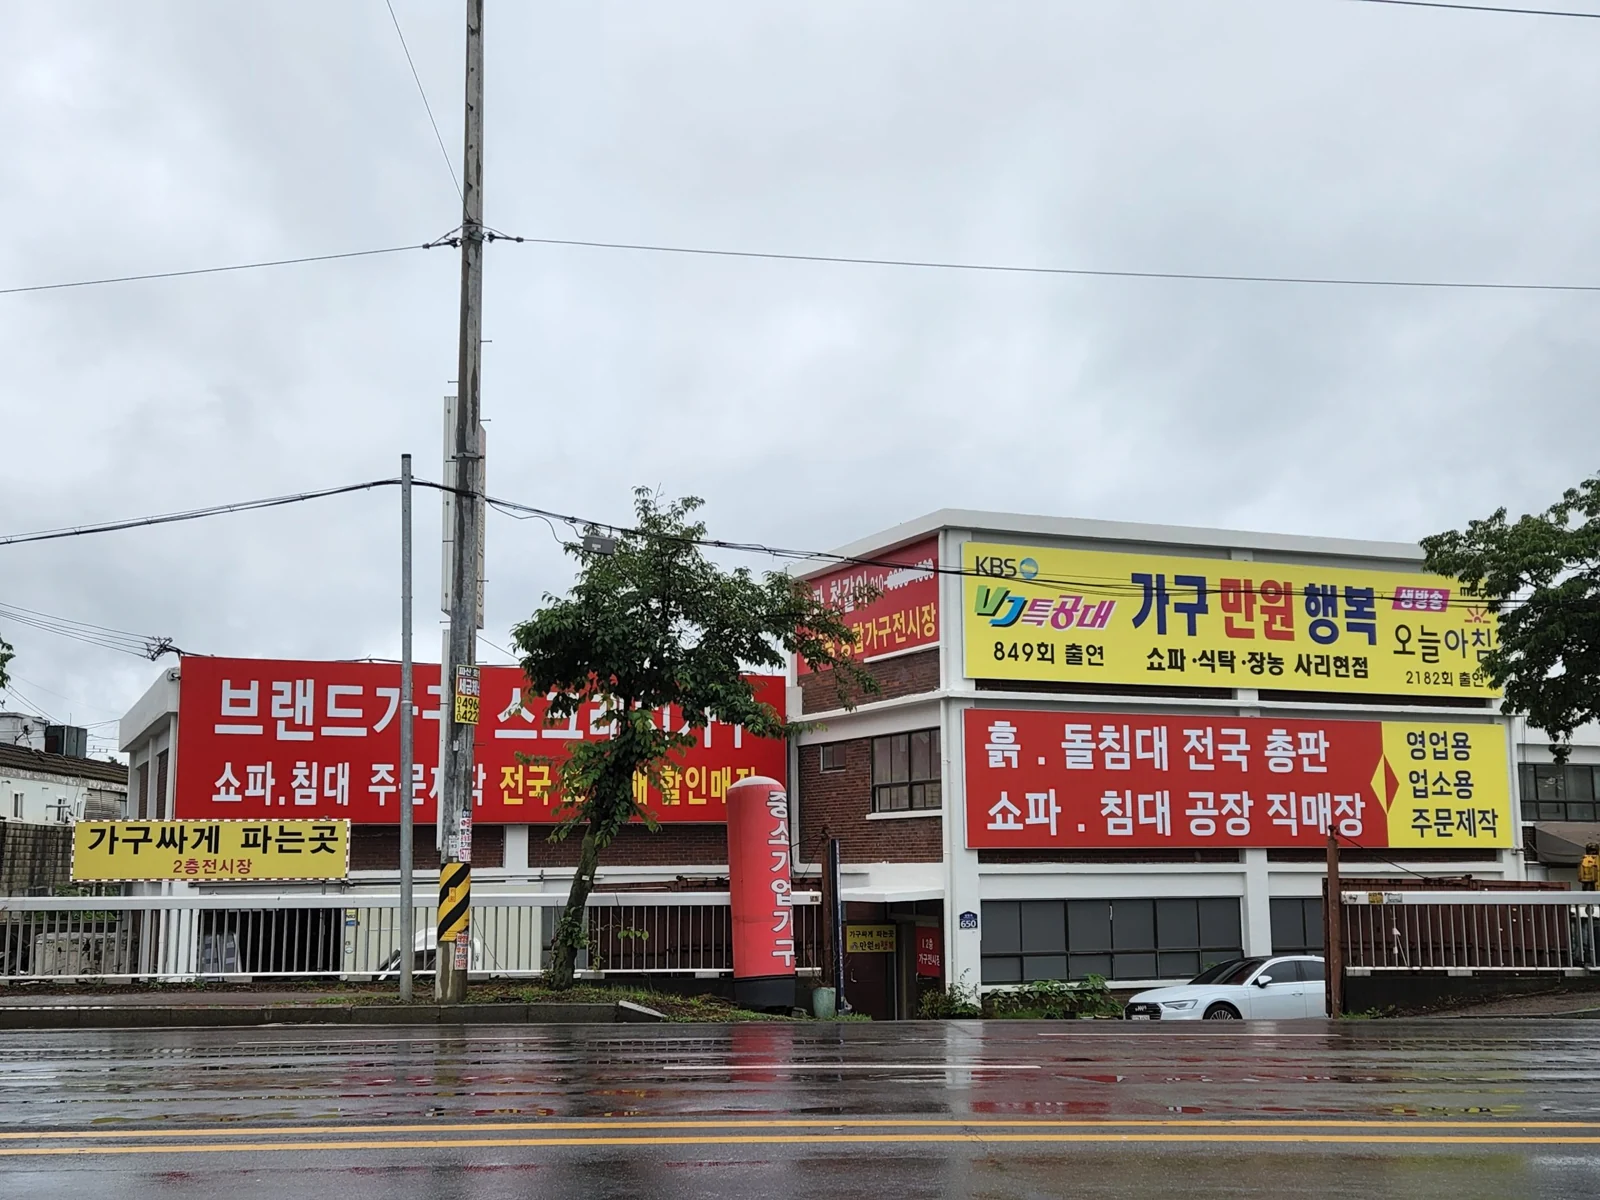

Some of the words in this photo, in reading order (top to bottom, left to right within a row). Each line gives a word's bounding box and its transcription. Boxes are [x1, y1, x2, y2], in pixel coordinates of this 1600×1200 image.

[976, 556, 1017, 578] KBS
[1131, 573, 1208, 636] 가구
[1220, 578, 1295, 641] 만원
[1304, 583, 1377, 645] 행복
[1400, 589, 1444, 610] 생방송
[994, 641, 1055, 664] 849회
[1065, 643, 1104, 666] 출연
[1393, 624, 1492, 663] 오늘아침
[1294, 653, 1369, 679] 사리현점
[1406, 671, 1453, 686] 2182회
[1459, 671, 1484, 687] 출연
[985, 721, 1021, 768] 흙
[1061, 724, 1169, 771] 돌침대
[1183, 726, 1251, 772] 전국
[1264, 729, 1330, 773] 총판
[1406, 731, 1472, 761] 영업용
[499, 765, 552, 806] 전국
[1409, 769, 1474, 799] 업소용
[987, 789, 1062, 836] 쇼파
[1100, 789, 1171, 836] 침대
[1185, 791, 1254, 837] 공장
[1266, 791, 1366, 837] 직매장
[1411, 808, 1498, 838] 주문제작
[88, 825, 221, 855] 가구싸게
[240, 825, 339, 854] 파는곳
[173, 858, 253, 874] 2층전시장
[960, 920, 976, 928] 650
